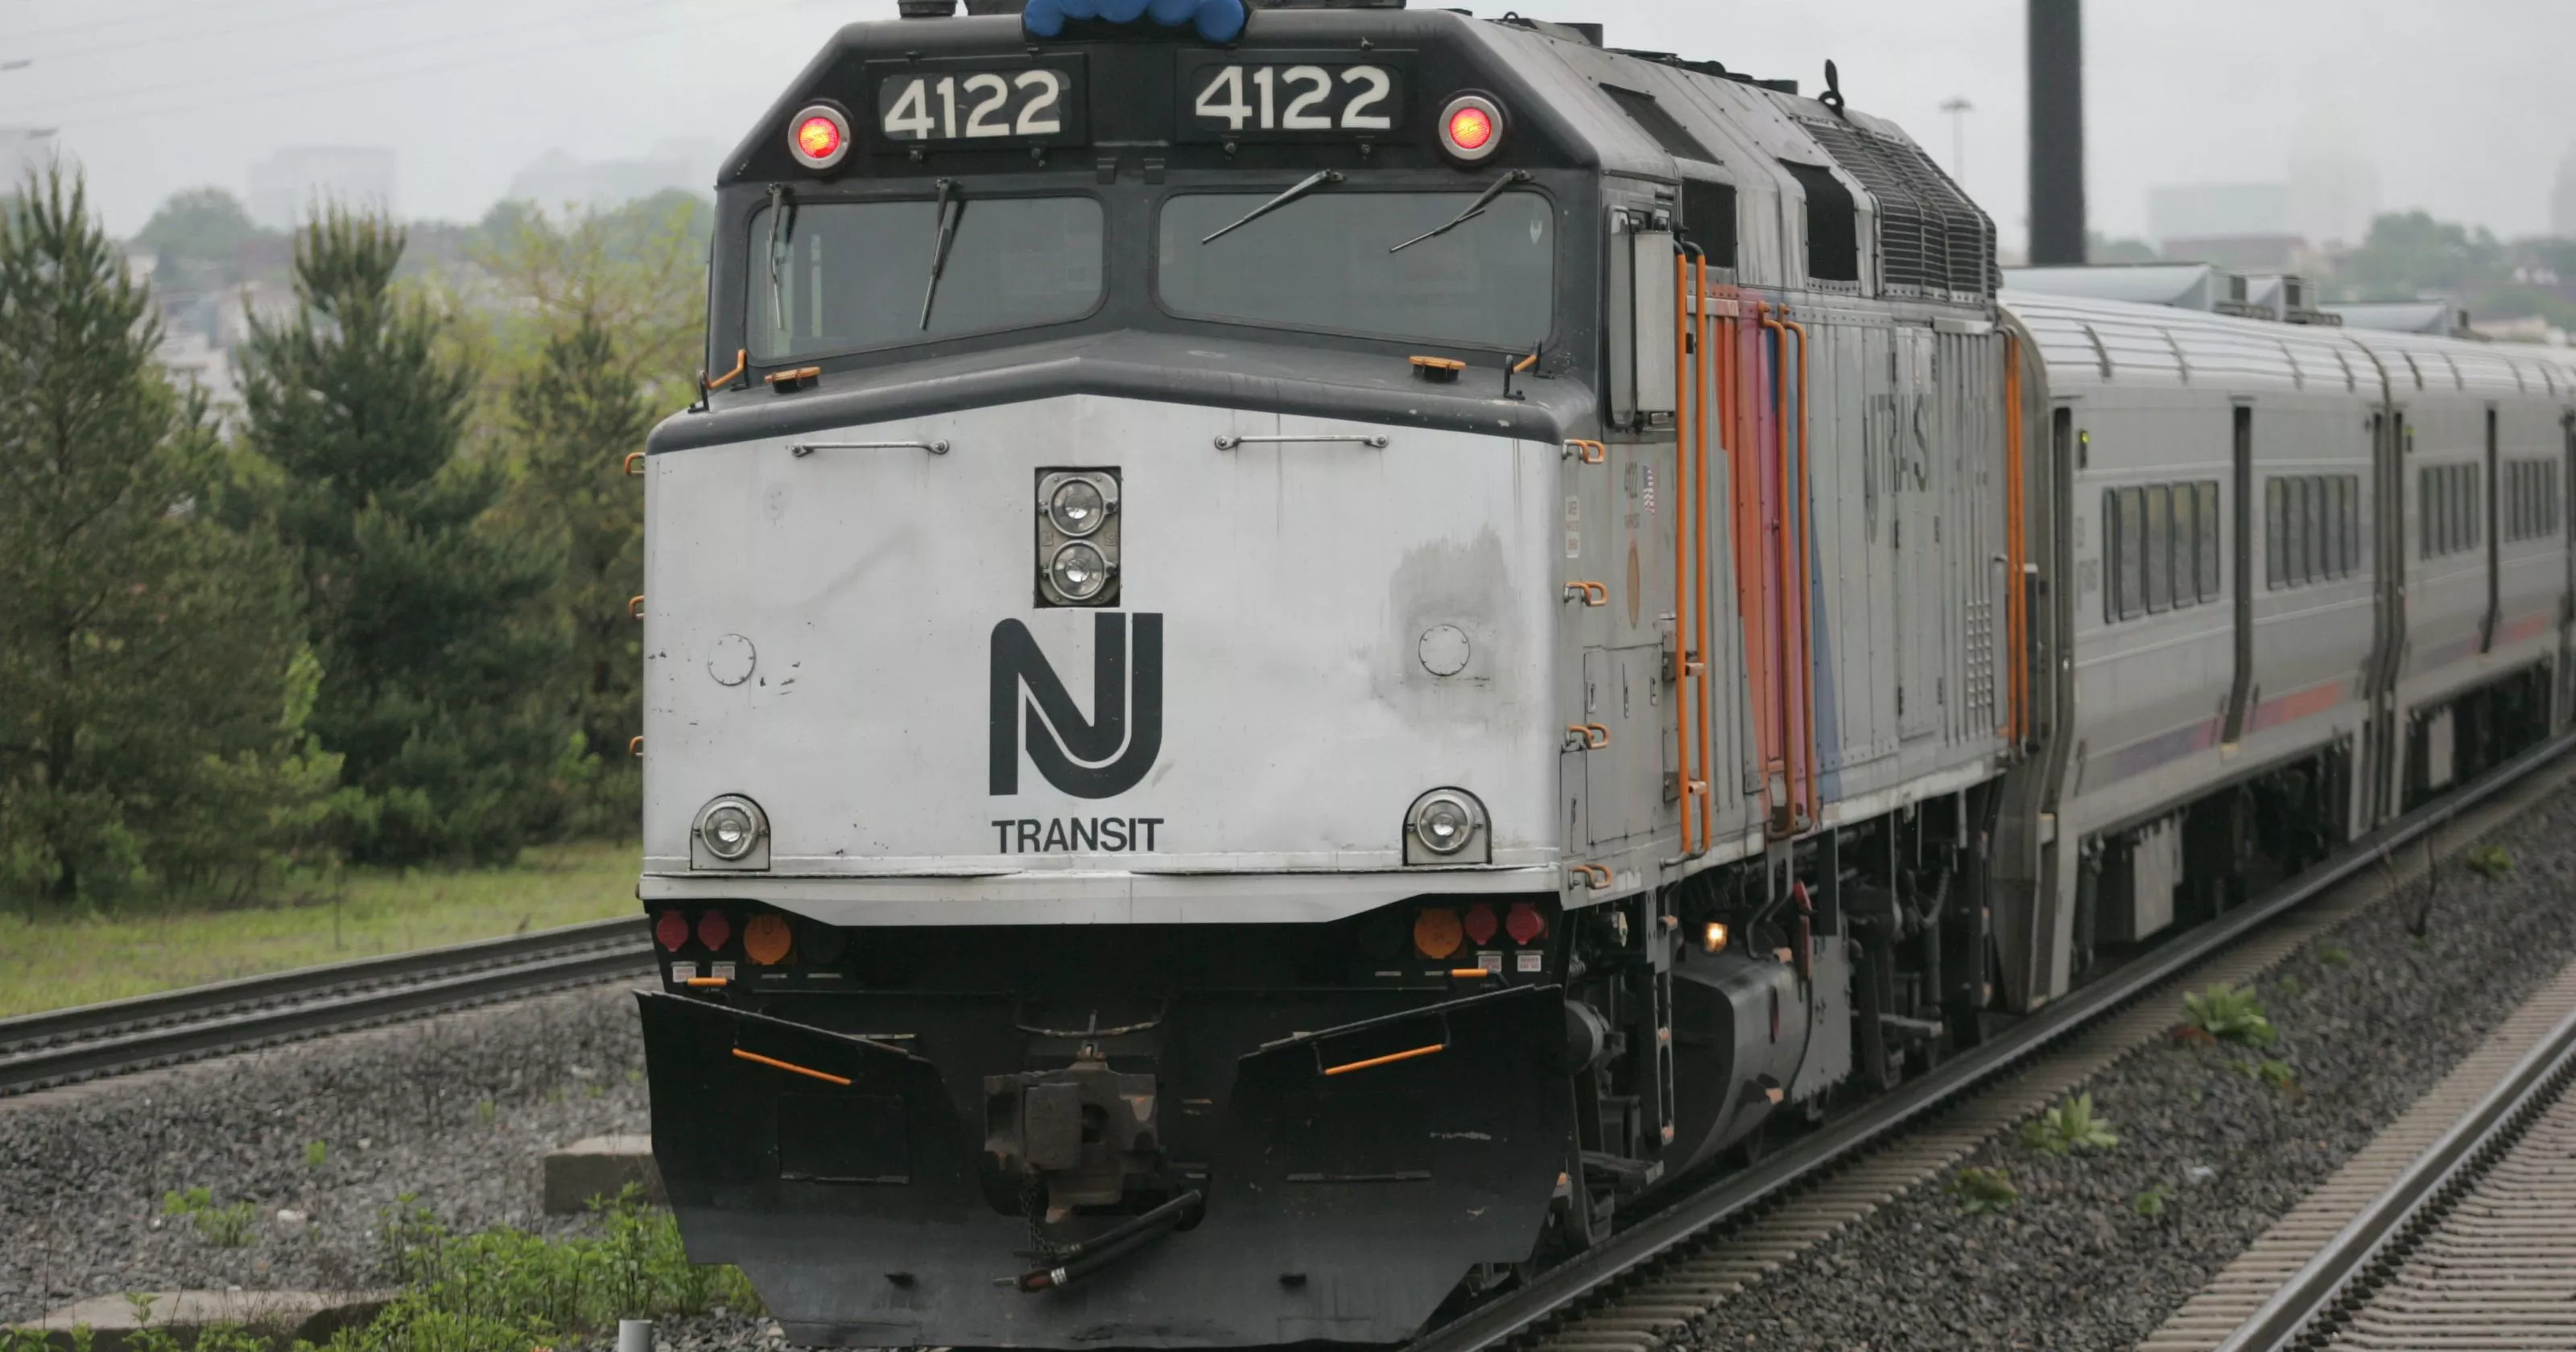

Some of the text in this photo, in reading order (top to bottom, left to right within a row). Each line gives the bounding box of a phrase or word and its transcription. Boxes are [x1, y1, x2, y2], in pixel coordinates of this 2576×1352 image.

[885, 70, 1060, 138] 4122
[1196, 65, 1390, 130] 4122
[989, 612, 1163, 799] NJ
[992, 818, 1164, 853] TRANSIT
